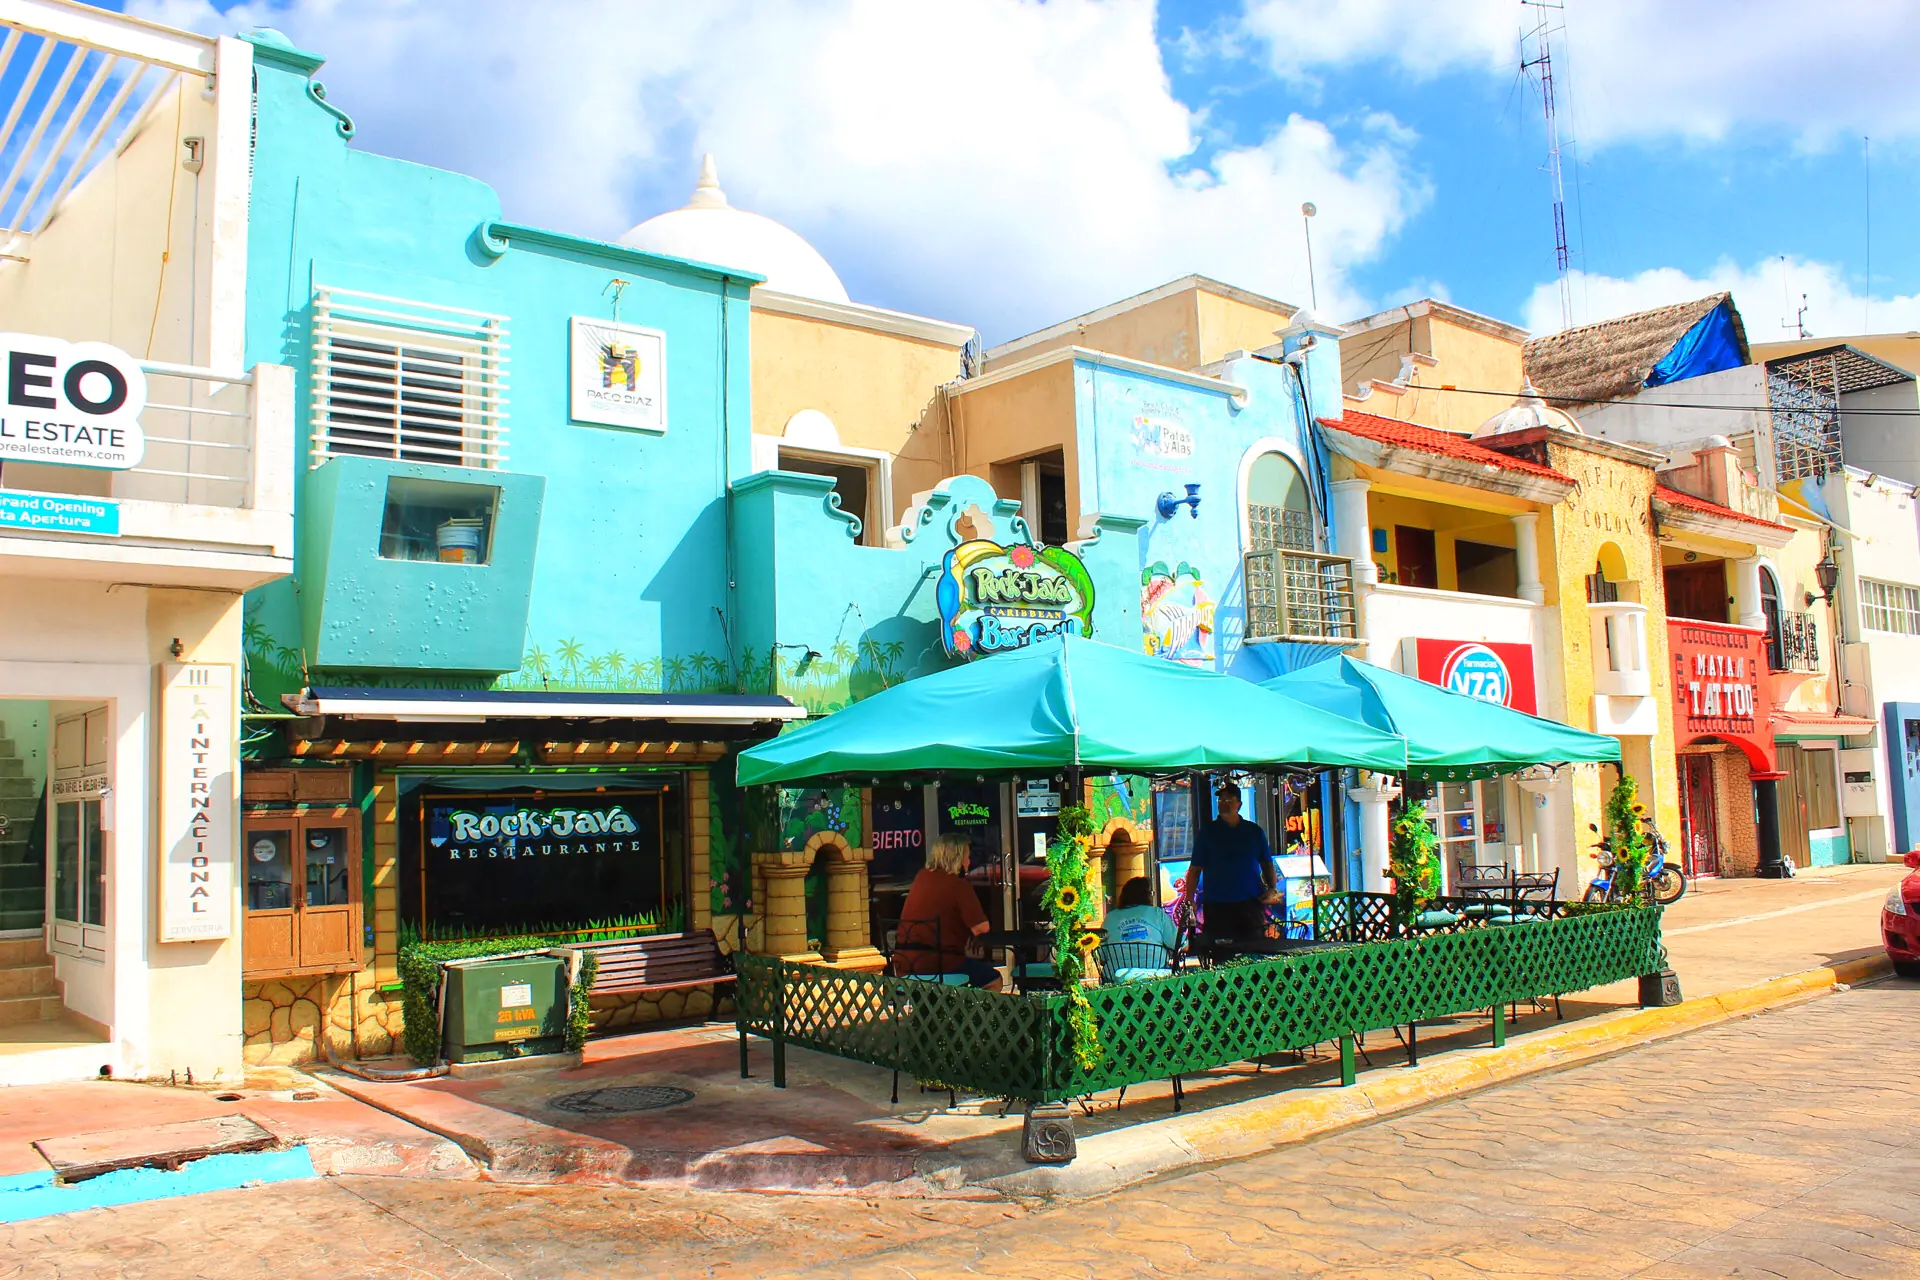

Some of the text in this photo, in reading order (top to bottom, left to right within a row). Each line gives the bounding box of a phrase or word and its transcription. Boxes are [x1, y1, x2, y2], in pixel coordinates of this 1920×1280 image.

[587, 389, 621, 402] PACO
[25, 419, 126, 448] ESTATE
[1163, 427, 1192, 443] Palas
[1171, 440, 1192, 456] Alas
[43, 499, 106, 517] Opening
[19, 510, 92, 528] Apertura
[988, 606, 1063, 620] CARIBBEAN
[979, 615, 1025, 650] Bar
[1696, 652, 1744, 679] MAYAN
[1688, 681, 1754, 716] TATTOO
[189, 722, 212, 913] INTERNACIONAL
[551, 808, 638, 836] Java
[955, 818, 988, 826] RESTAURANTE
[449, 840, 641, 860] RESTAURANTE
[497, 1009, 512, 1023] 25
